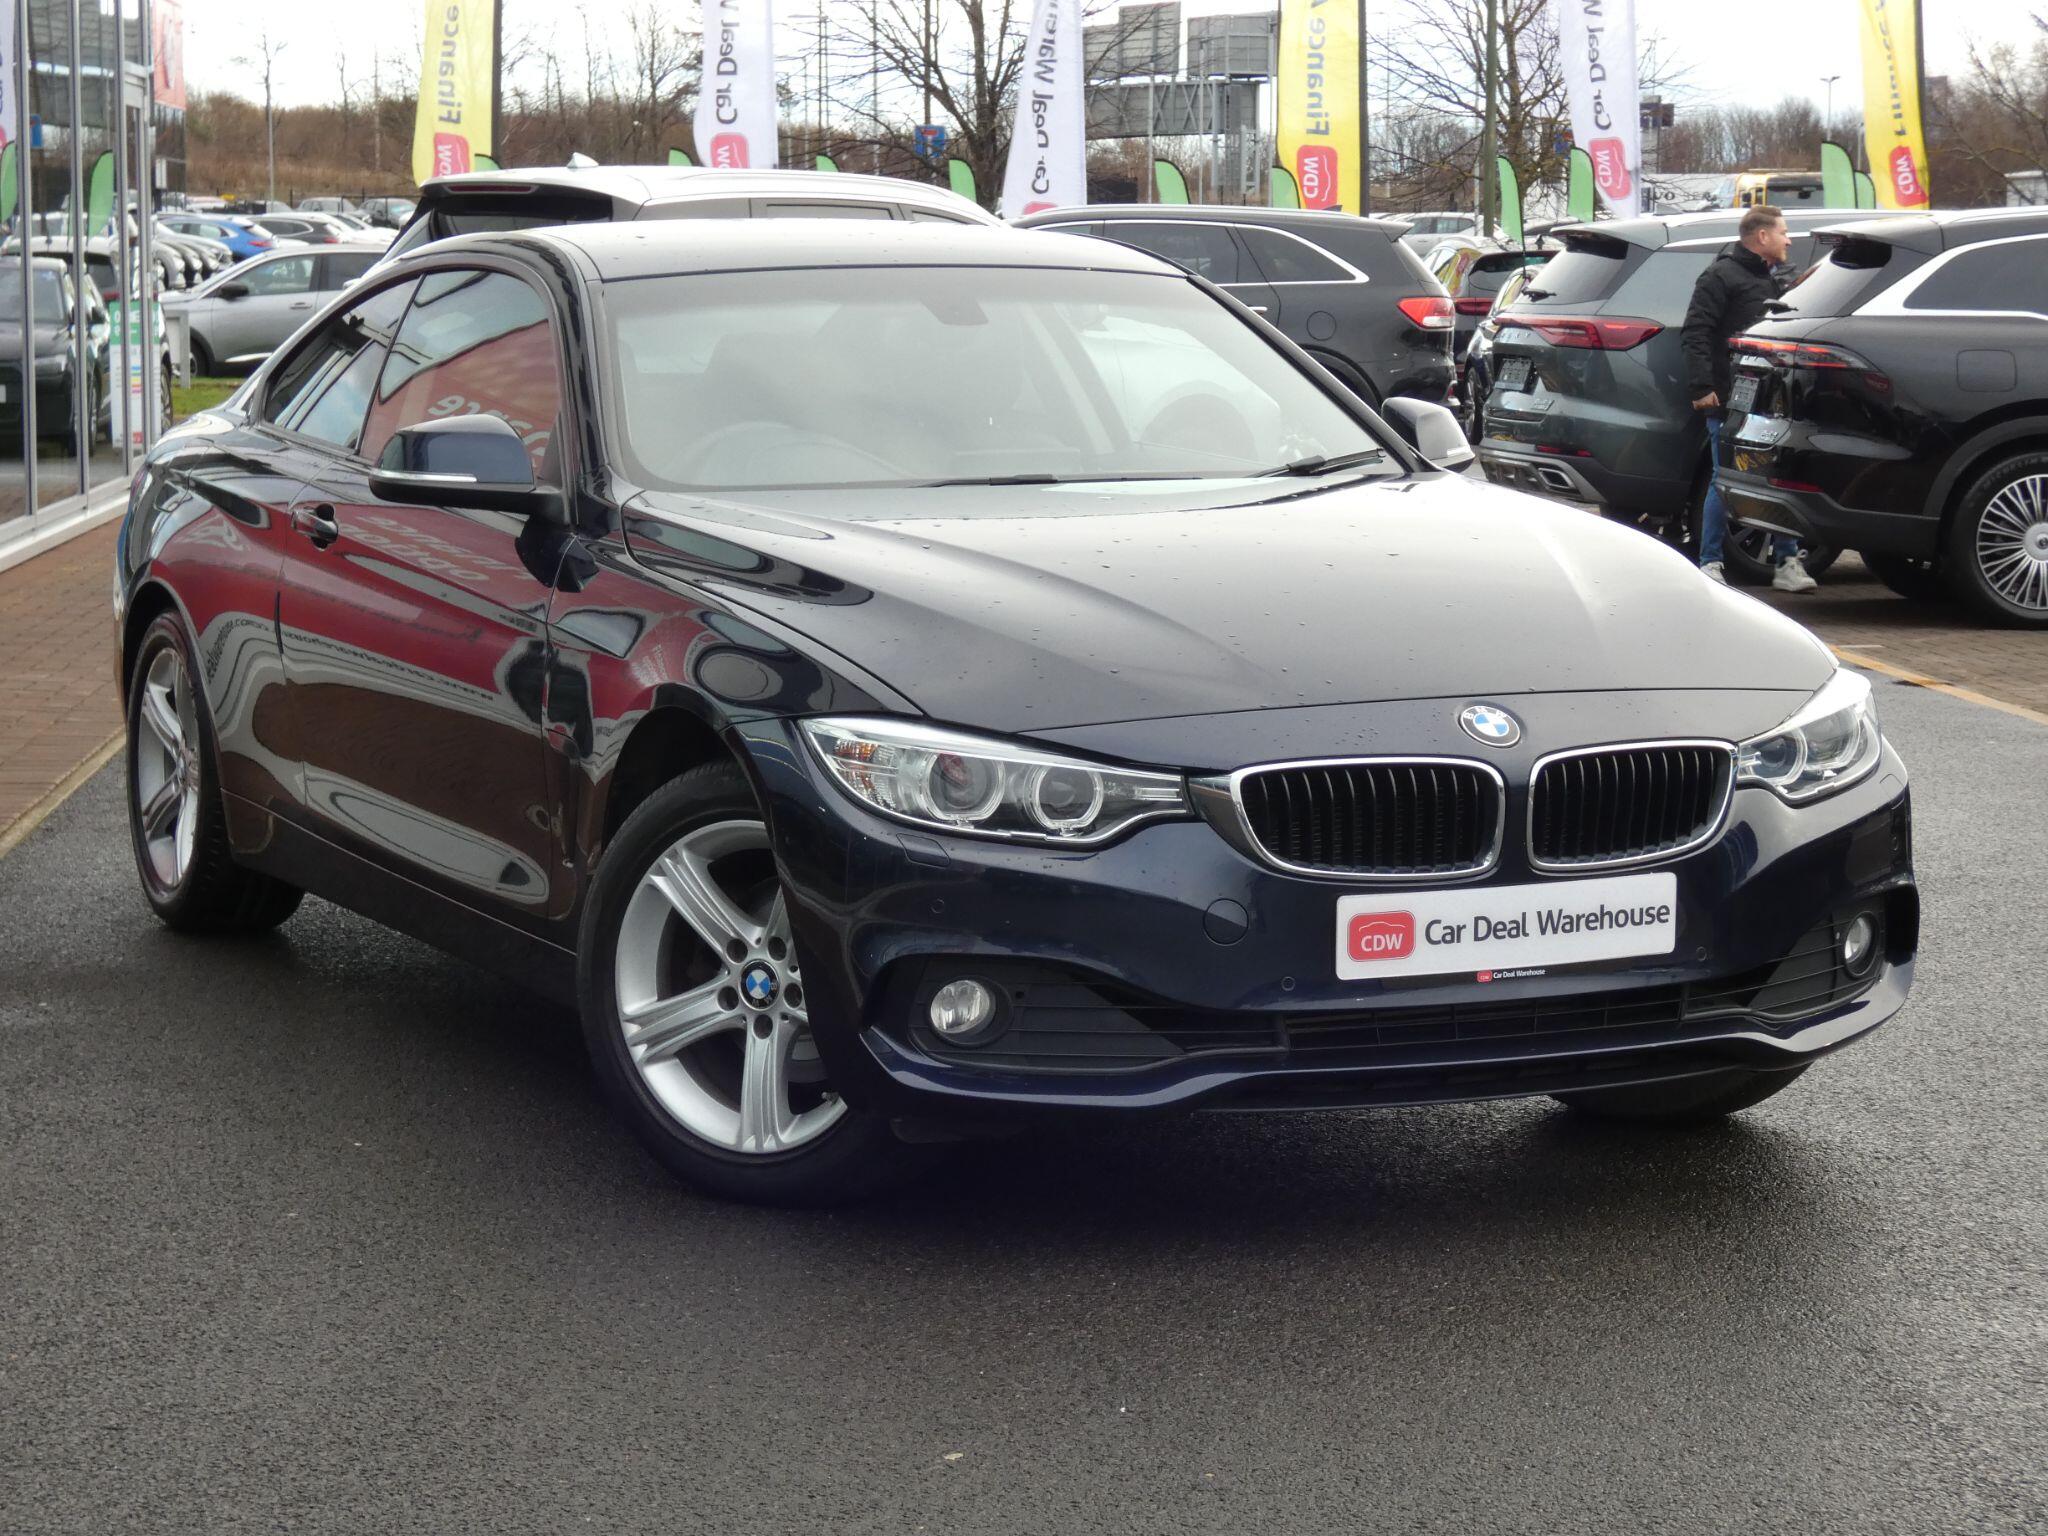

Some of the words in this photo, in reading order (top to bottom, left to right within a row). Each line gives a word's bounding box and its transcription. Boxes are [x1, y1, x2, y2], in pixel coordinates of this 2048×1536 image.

[1360, 932, 1404, 952] CDW
[1424, 918, 1467, 945] Car
[1473, 911, 1530, 942] Deal
[1536, 904, 1671, 936] Warehouse
[1493, 971, 1502, 979] Car
[1516, 969, 1546, 977] Warehouse
